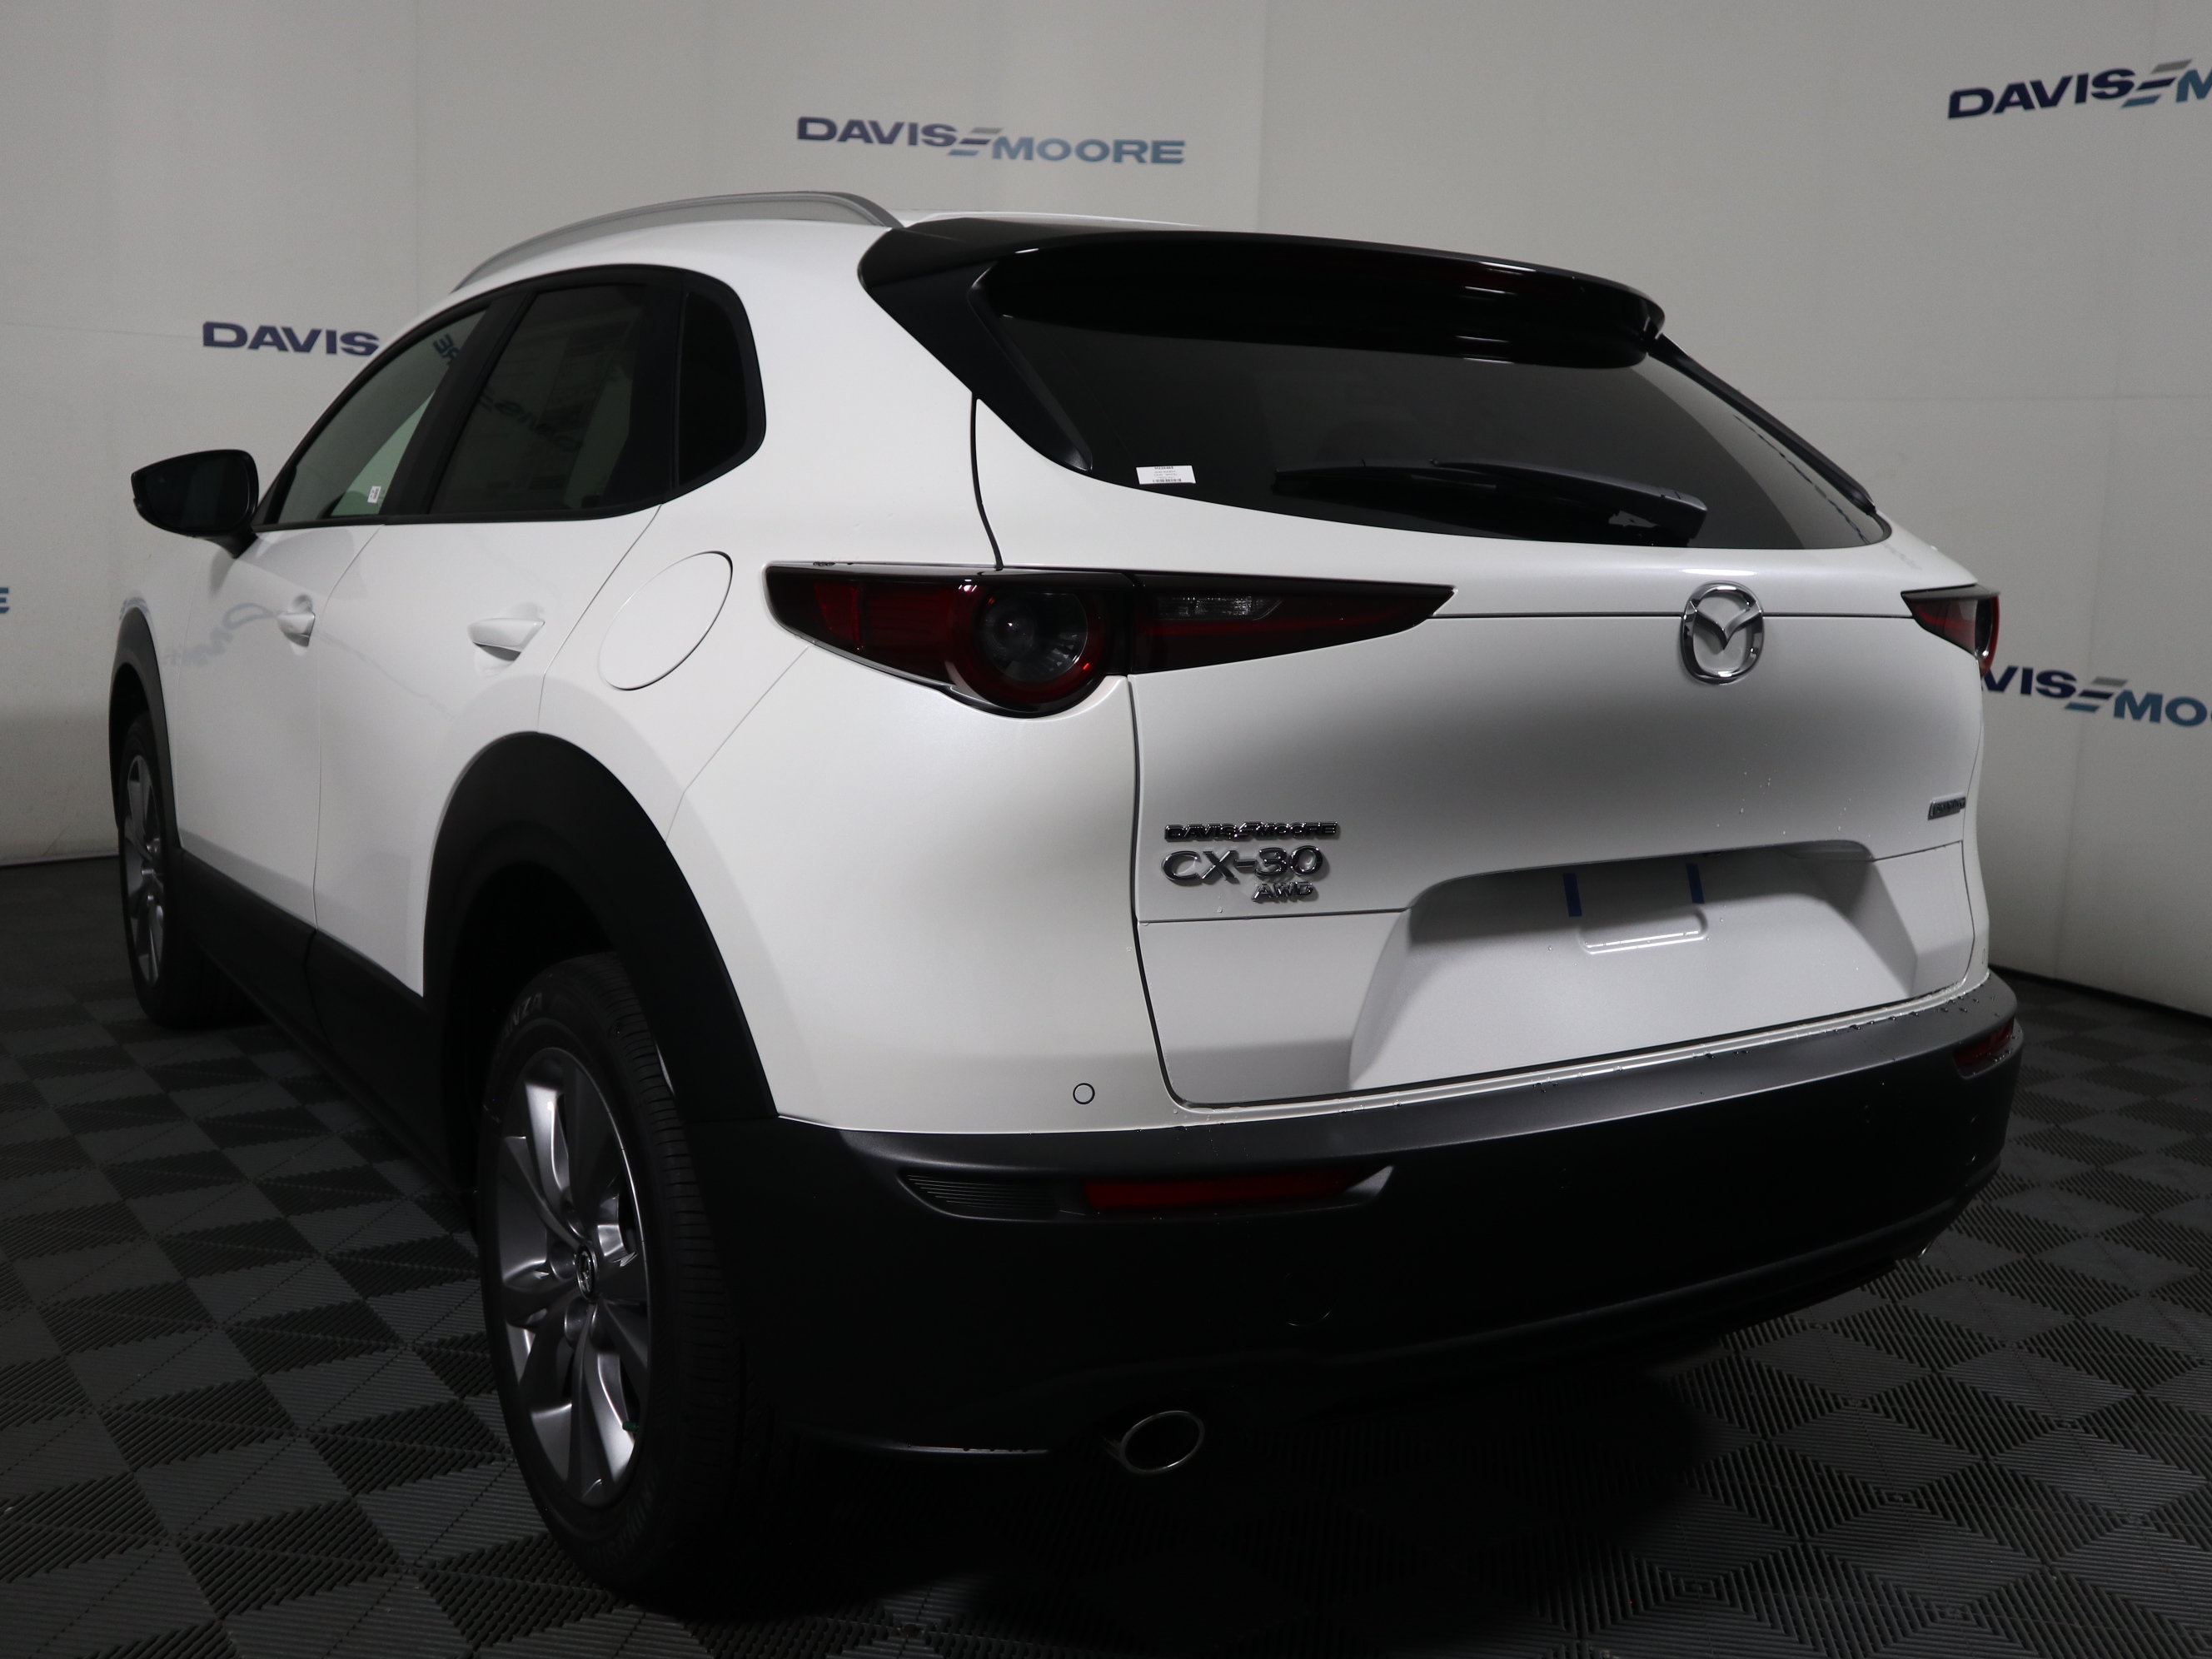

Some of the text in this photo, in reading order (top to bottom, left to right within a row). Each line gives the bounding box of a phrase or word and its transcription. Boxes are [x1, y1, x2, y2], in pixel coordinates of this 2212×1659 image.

[1947, 68, 2135, 119] DAVIS
[796, 116, 1185, 164] DAVIS MOORE
[202, 321, 380, 356] DAVIS
[2113, 690, 2212, 727] MO
[1162, 844, 1324, 882] CX-30
[1251, 881, 1315, 902] AWD
